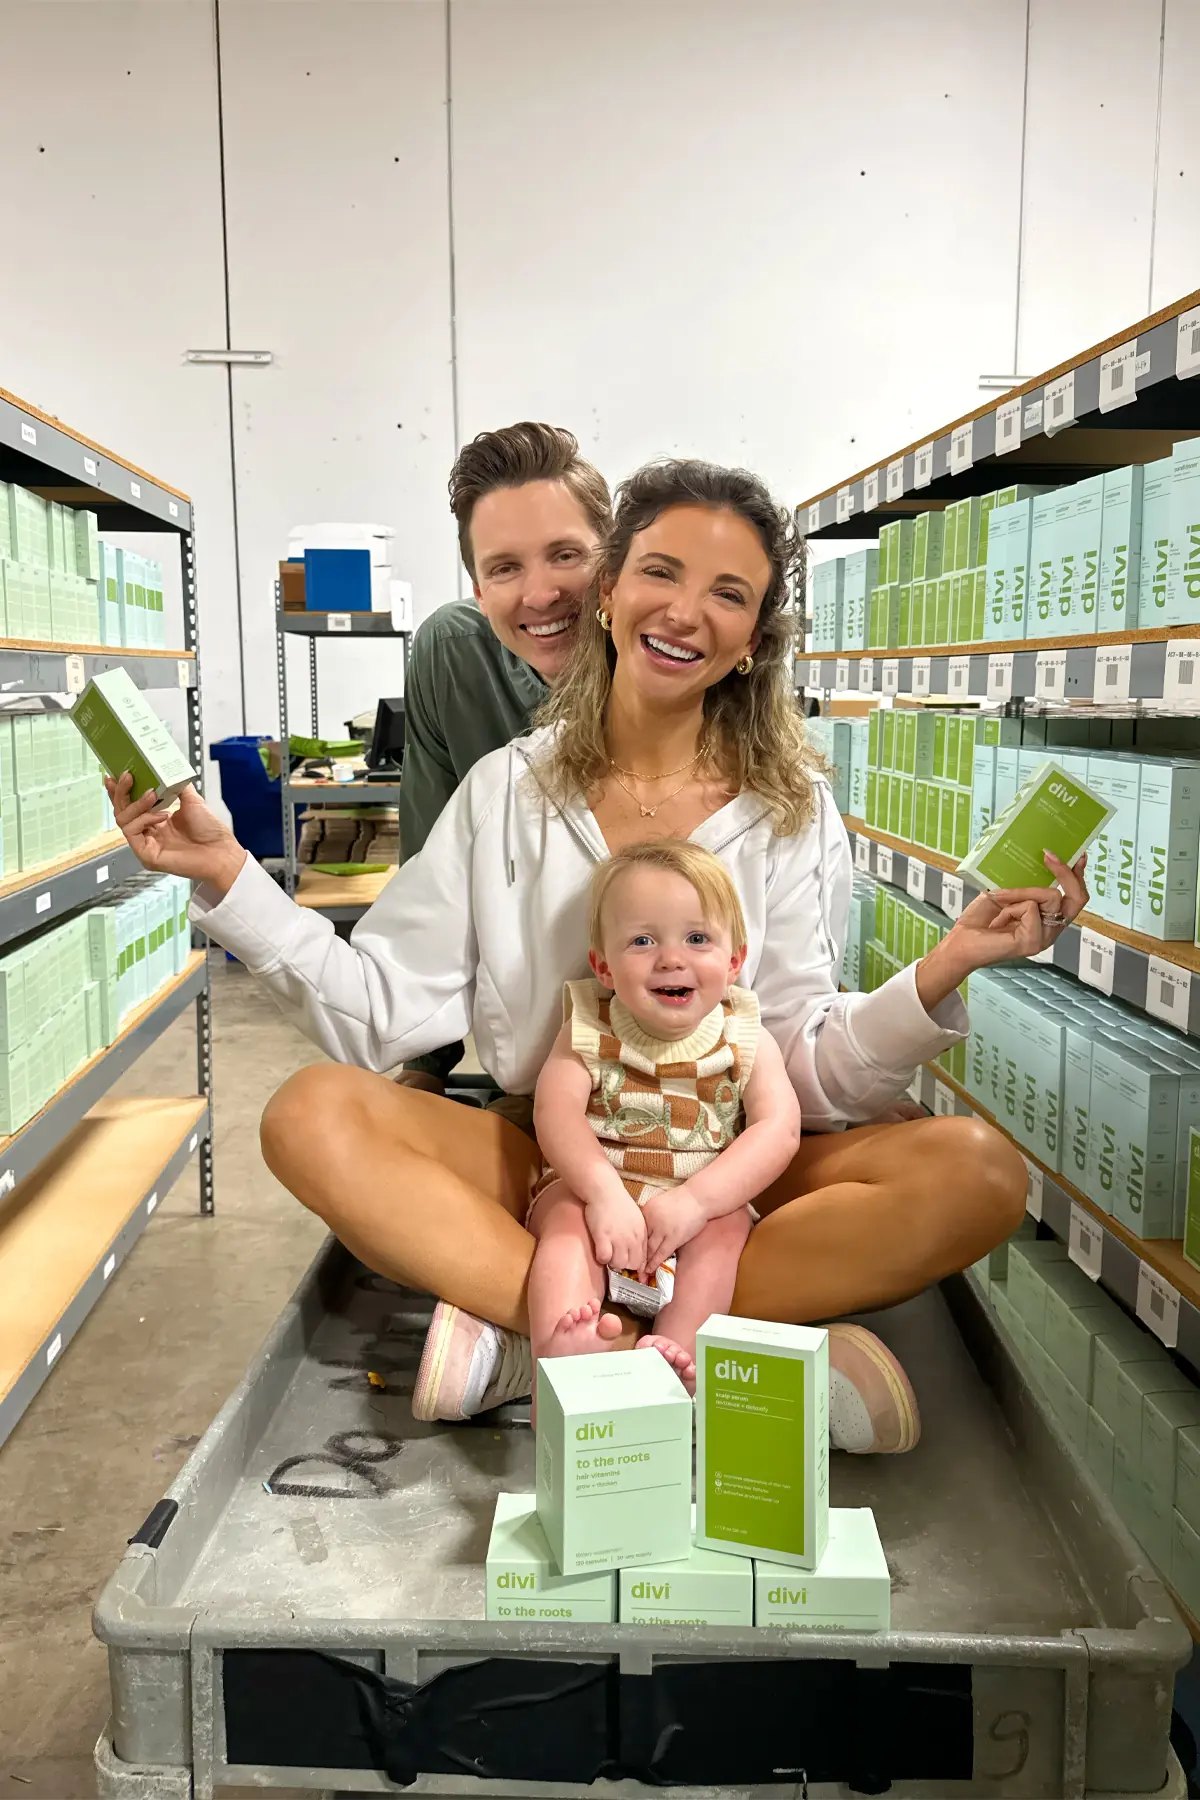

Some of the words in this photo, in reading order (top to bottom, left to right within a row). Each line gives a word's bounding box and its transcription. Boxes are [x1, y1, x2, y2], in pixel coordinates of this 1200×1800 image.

[1058, 556, 1073, 616] divi
[1081, 550, 1097, 614] divi
[1111, 545, 1127, 611] divi
[1152, 539, 1168, 608] divi
[1183, 523, 1200, 598] divi
[992, 570, 1004, 624] divi
[1012, 566, 1024, 622] divi
[1037, 561, 1051, 619] divi
[1048, 782, 1079, 807] divi
[1094, 833, 1108, 897] divi
[1117, 839, 1134, 906] divi
[1148, 845, 1166, 916] divi
[973, 1032, 984, 1086] divi
[1005, 1058, 1016, 1116] divi
[1023, 1072, 1036, 1133] divi
[1045, 1089, 1057, 1151] divi
[1073, 1105, 1088, 1171] divi
[1098, 1122, 1115, 1191] divi
[1126, 1142, 1144, 1214] divi
[715, 1360, 759, 1384] divi
[576, 1421, 614, 1441] divi
[576, 1460, 590, 1468] to
[593, 1456, 614, 1467] the
[618, 1452, 650, 1464] roots
[576, 1473, 589, 1481] hair
[496, 1572, 536, 1589] divi
[631, 1582, 671, 1600] divi
[767, 1587, 808, 1604] divi
[497, 1606, 512, 1616] to
[516, 1606, 536, 1617] the
[539, 1607, 572, 1618] roots
[632, 1616, 646, 1624] to
[649, 1616, 671, 1625] the
[674, 1618, 708, 1626] roots
